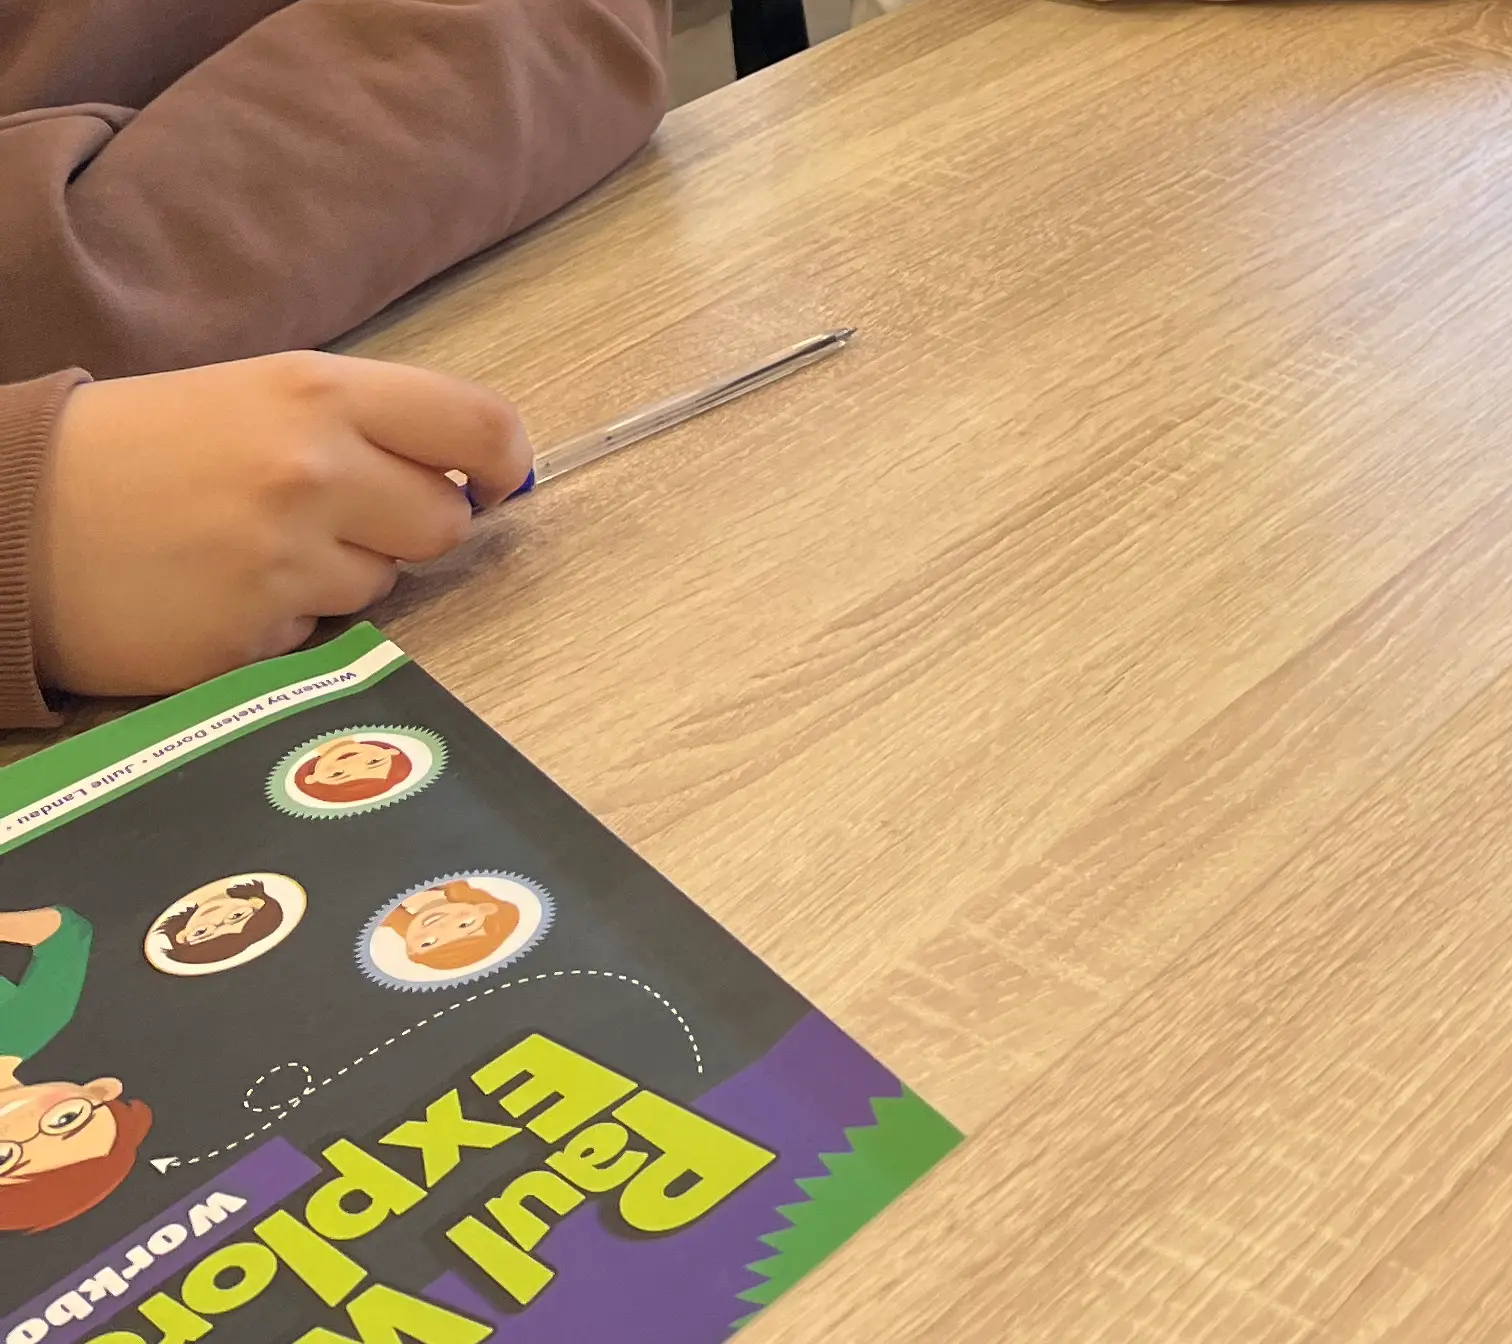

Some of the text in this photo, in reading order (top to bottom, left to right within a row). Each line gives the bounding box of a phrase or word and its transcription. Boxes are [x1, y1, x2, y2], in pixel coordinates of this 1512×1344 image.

[16, 670, 357, 826] Written by Helen Doron Julie Landau
[446, 1090, 777, 1305] Paul
